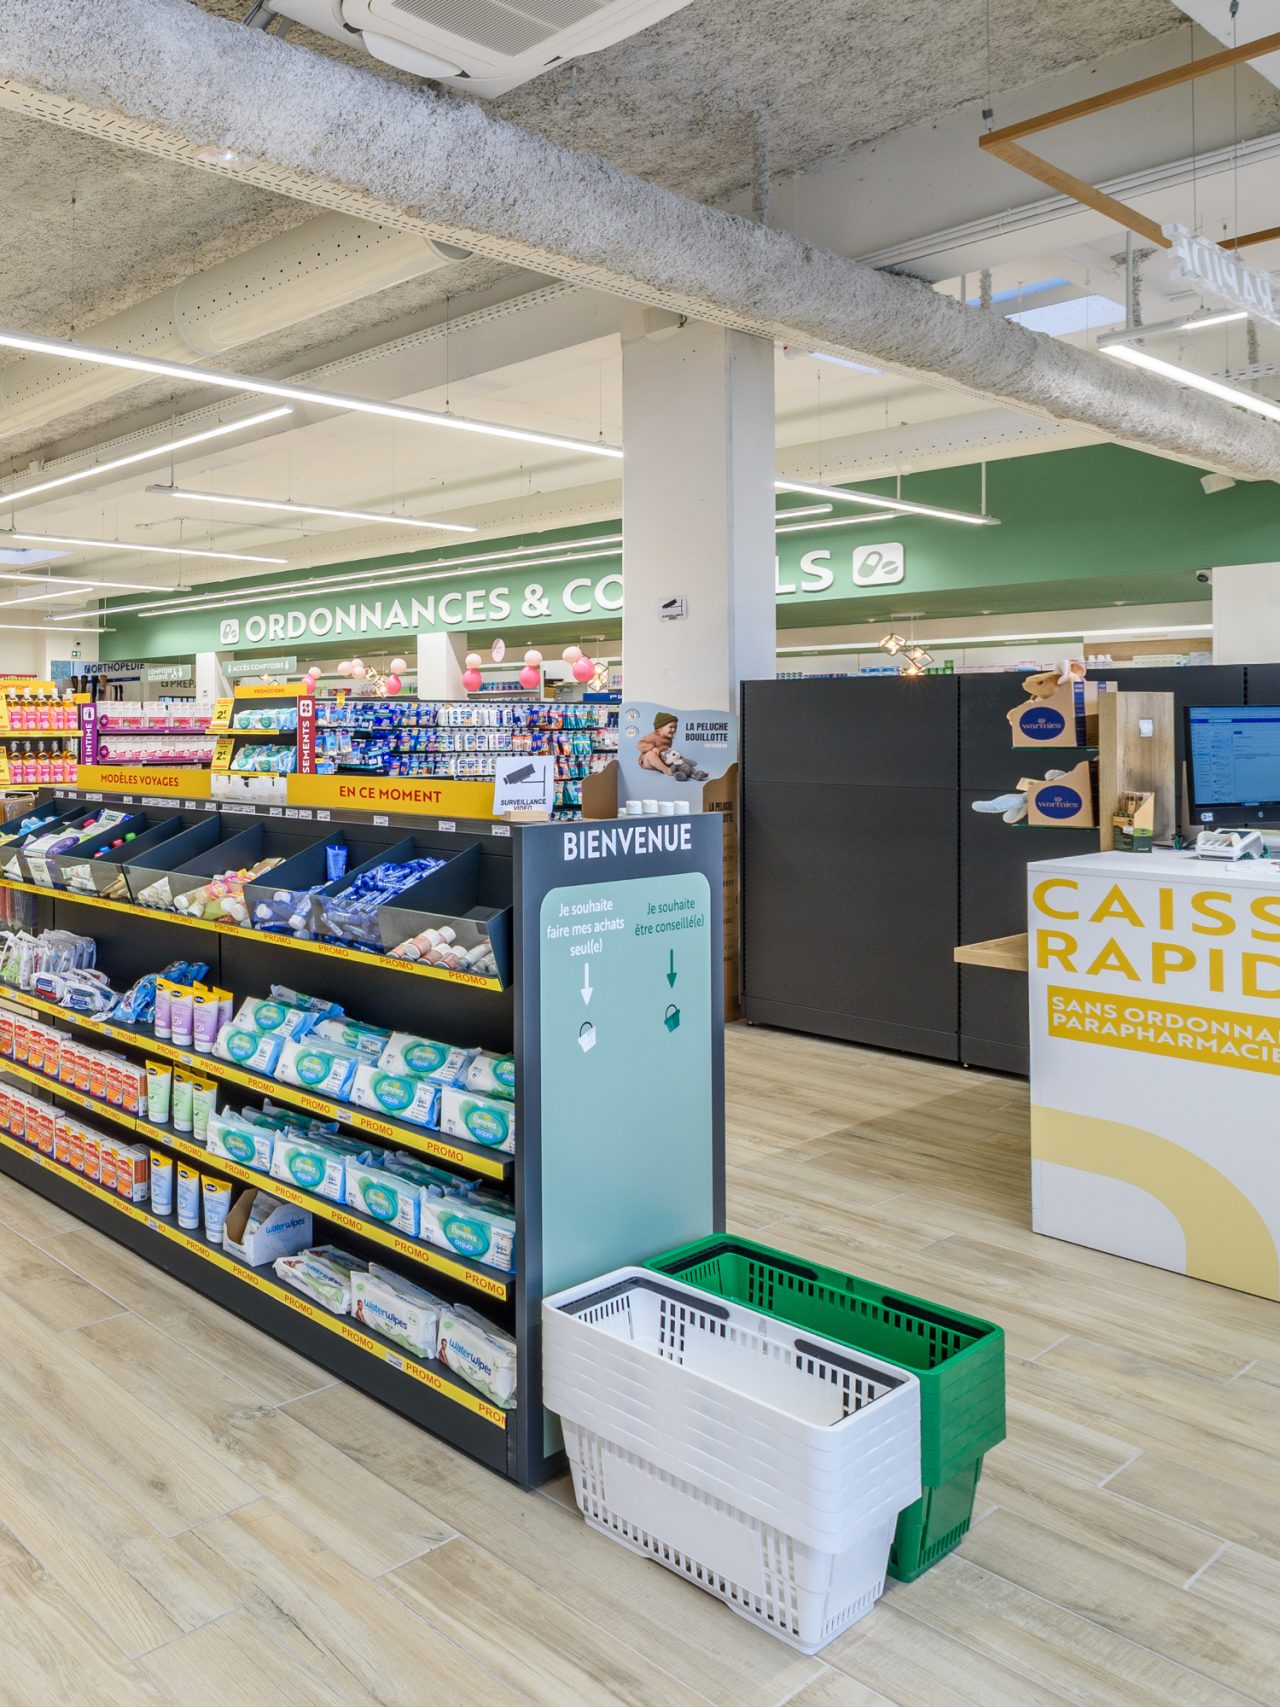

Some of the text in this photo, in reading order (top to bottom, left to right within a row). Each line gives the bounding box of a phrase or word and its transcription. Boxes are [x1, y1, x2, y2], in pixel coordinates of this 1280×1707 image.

[245, 585, 511, 643] ORDONNANCES
[521, 582, 552, 618] &
[233, 662, 284, 672] ACCÈS COMPTOIRS
[685, 722, 729, 731] LA PELUCHE
[85, 723, 93, 755] INTIME
[685, 732, 729, 742] BOUILLOTTE
[101, 771, 180, 787] MODÈLES VOYAGES
[339, 786, 442, 803] EN CE MOMENT
[500, 798, 547, 806] SURVEILLANCE
[563, 823, 692, 861] BIENVENUE
[129, 905, 150, 916] PROMO
[559, 899, 614, 917] Je souhaite
[647, 897, 696, 915] Je souhaite
[170, 914, 192, 925] PROMO
[214, 923, 239, 934] PROMO
[546, 917, 625, 940] faire mes achats
[634, 913, 705, 937] être conseillé(e)
[264, 933, 291, 945] PROMO
[570, 938, 603, 958] seul(e)
[318, 944, 349, 957] PROMO
[379, 957, 414, 971] PROMO
[1036, 928, 1280, 999] RAPID
[448, 971, 487, 987] PROMO
[1051, 996, 1280, 1045] SANS ORDONNA
[117, 1032, 138, 1044] PROMO
[157, 1044, 179, 1058] PROMO
[200, 1061, 225, 1075] PROMO
[248, 1077, 275, 1094] PROMO
[301, 1096, 331, 1114] PROMO
[138, 1122, 159, 1137] PROMO
[360, 1117, 393, 1137] PROMO
[179, 1141, 202, 1158] PROMO
[426, 1141, 464, 1162] PROMO
[224, 1162, 250, 1180] PROMO
[275, 1185, 304, 1204] PROMO
[113, 1198, 133, 1215] PROMO
[331, 1211, 363, 1231] PROMO
[186, 1239, 210, 1258] PROMO
[394, 1239, 430, 1262] PROMO
[232, 1264, 259, 1286] PROMO
[465, 1272, 505, 1297] PROMO
[284, 1294, 313, 1316] PROMO
[341, 1326, 374, 1350] PROMO
[406, 1362, 442, 1390] PROMO
